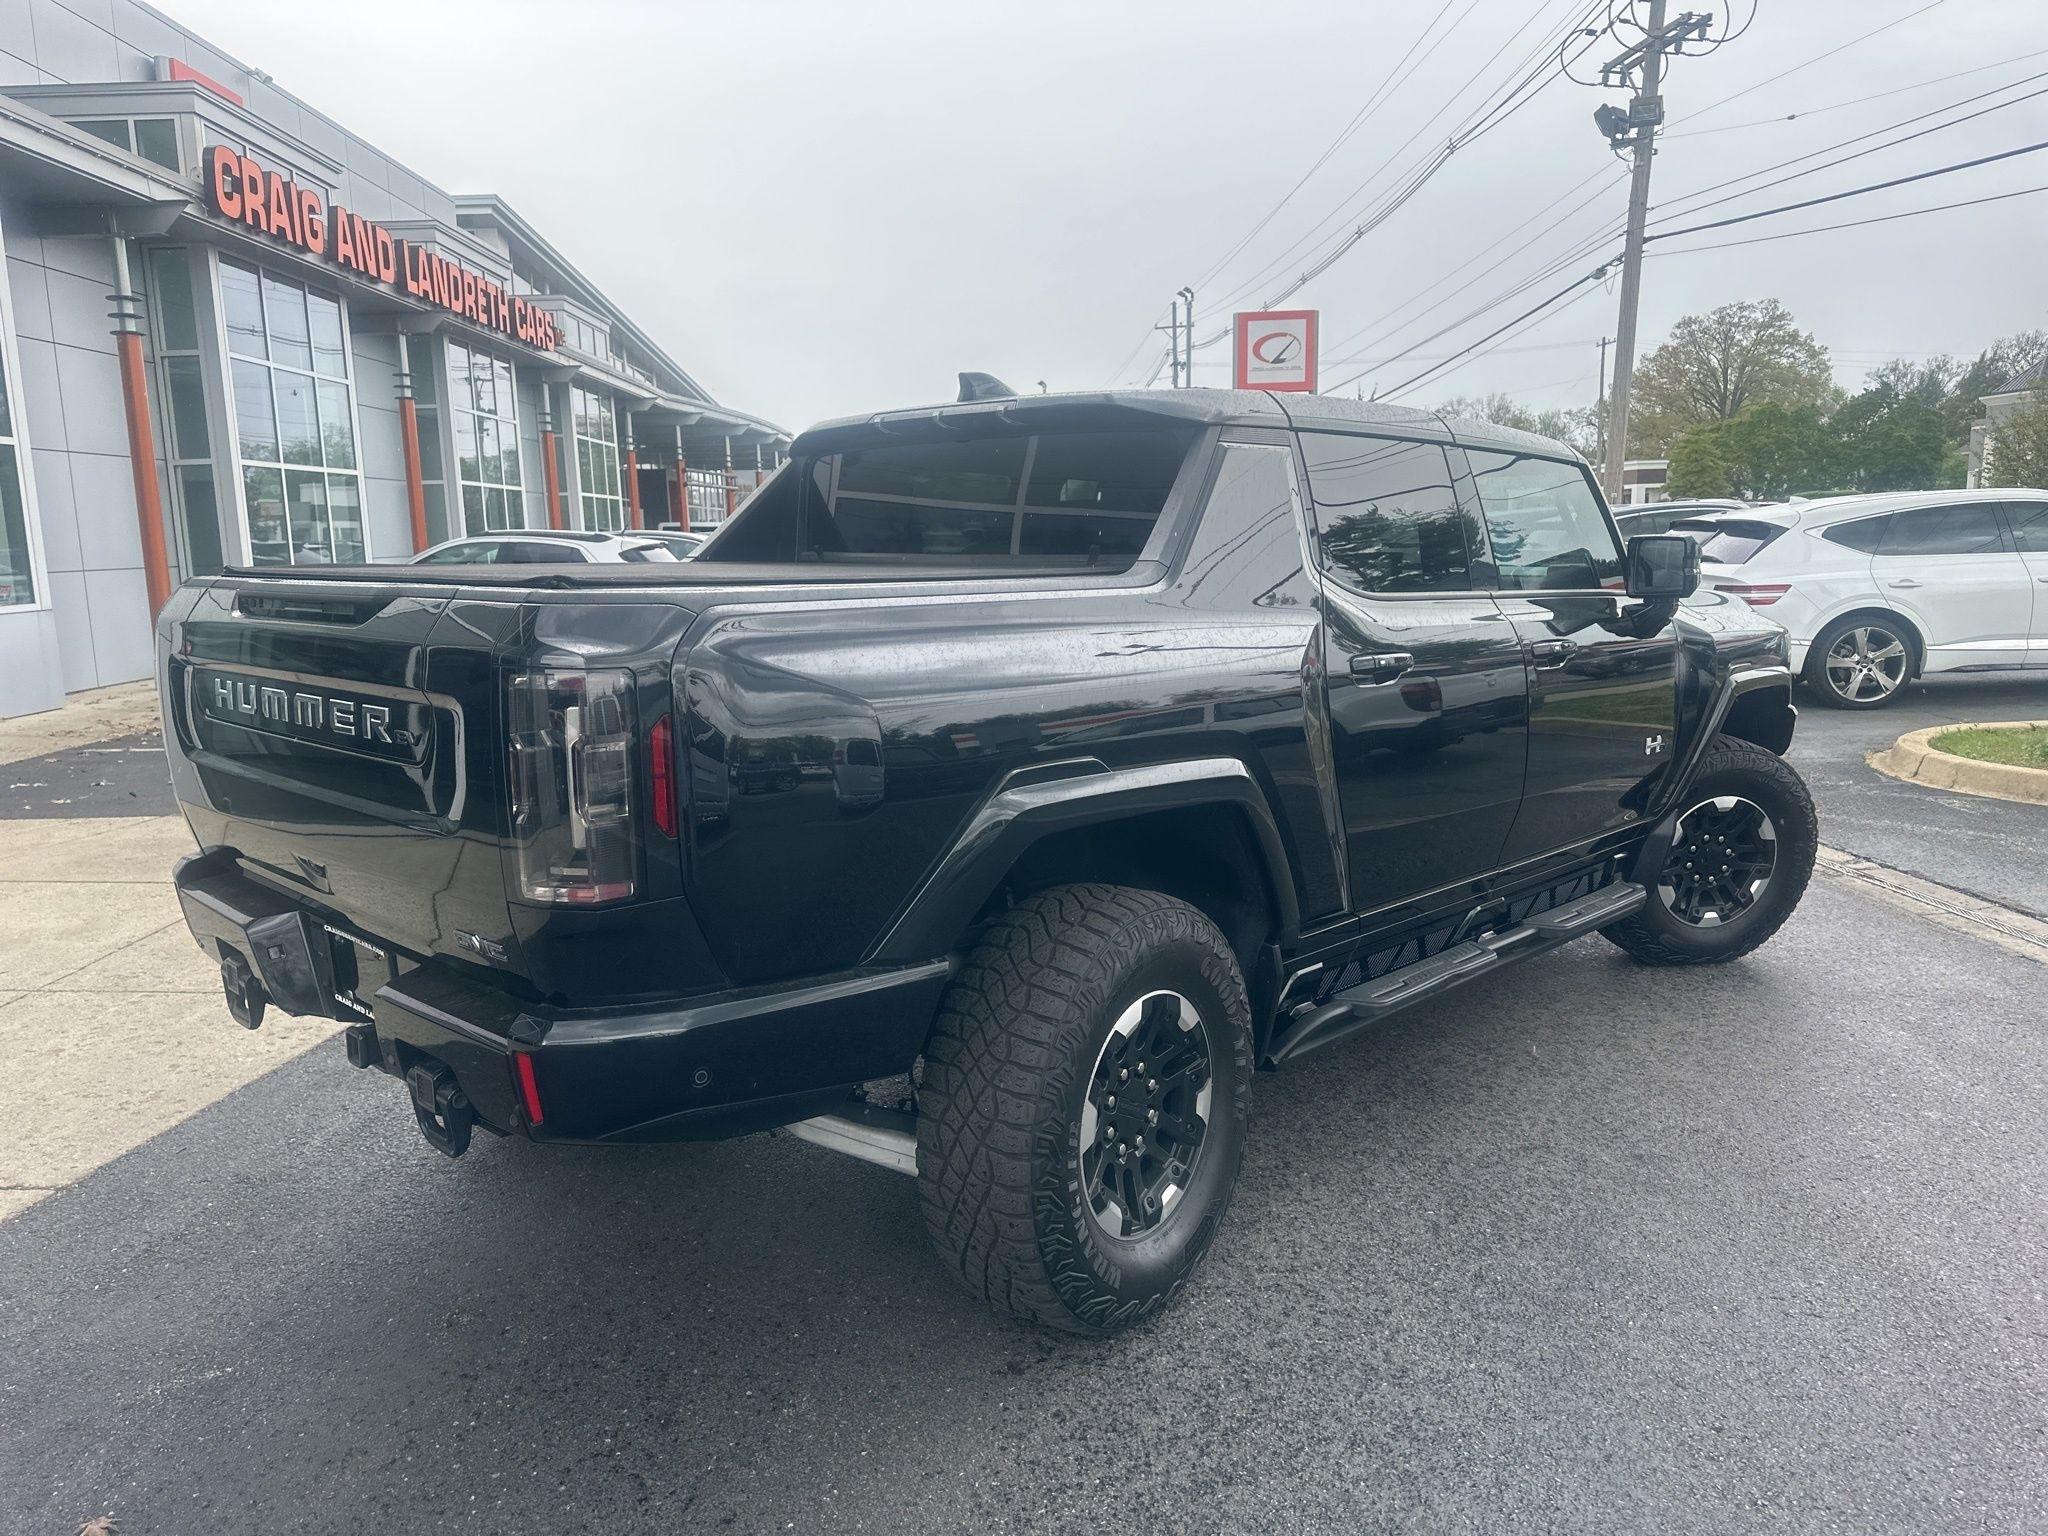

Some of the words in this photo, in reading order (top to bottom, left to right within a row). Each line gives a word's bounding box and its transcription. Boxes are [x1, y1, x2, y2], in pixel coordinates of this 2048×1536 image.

[211, 144, 325, 254] CRAIG
[336, 205, 396, 284] AND
[402, 239, 511, 333] LANDRETH
[514, 296, 555, 351] CARS
[214, 678, 392, 744] HUMMER
